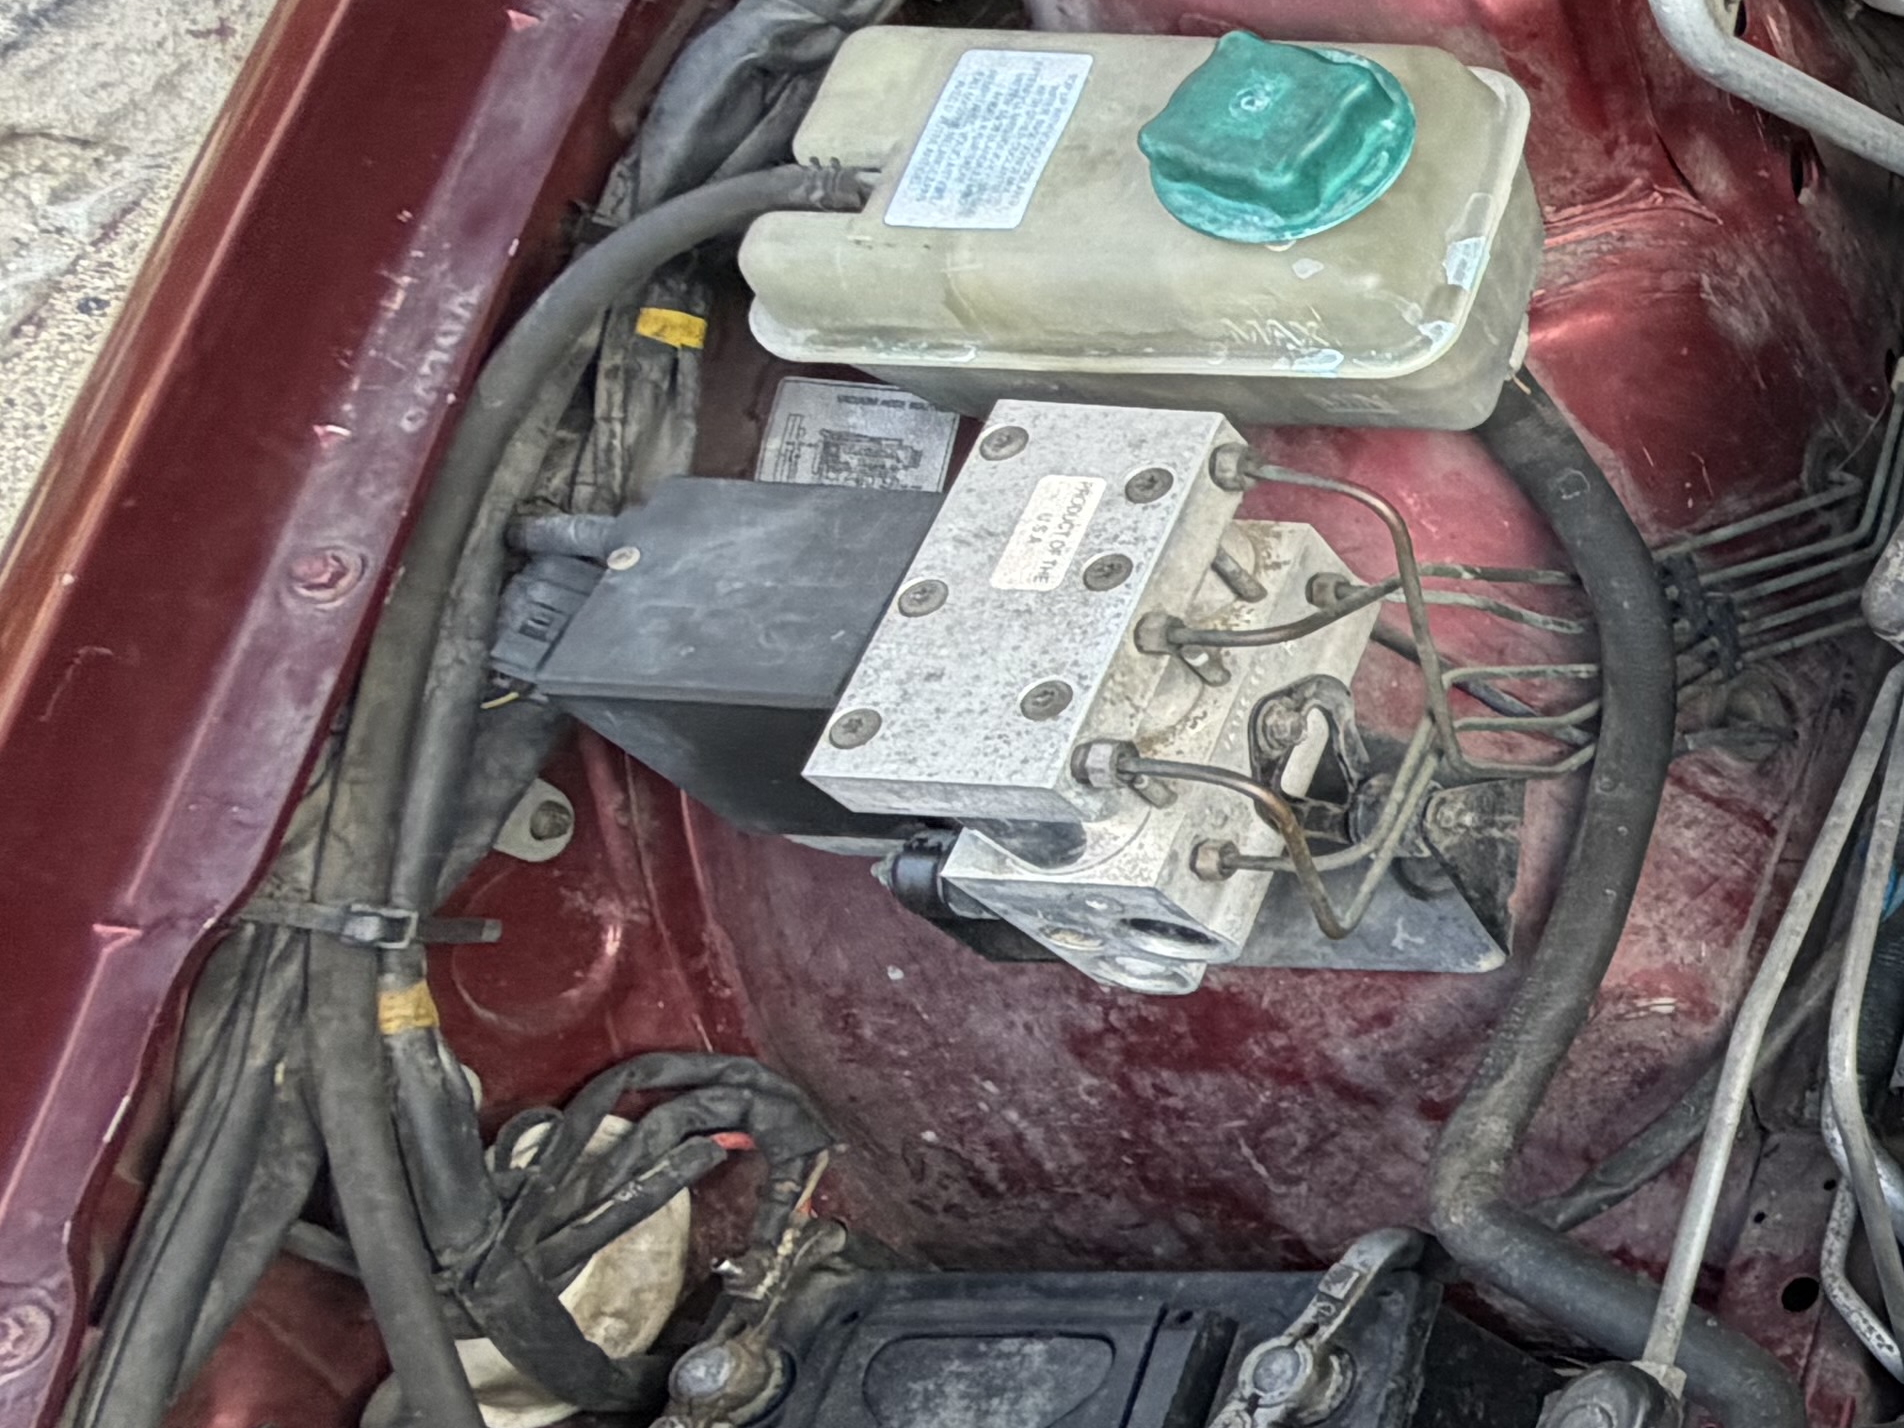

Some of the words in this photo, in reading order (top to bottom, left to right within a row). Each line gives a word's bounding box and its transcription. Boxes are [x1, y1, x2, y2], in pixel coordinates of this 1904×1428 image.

[1053, 482, 1093, 537] PRODUCT
[1049, 540, 1065, 555] OF
[1033, 560, 1057, 583] THE
